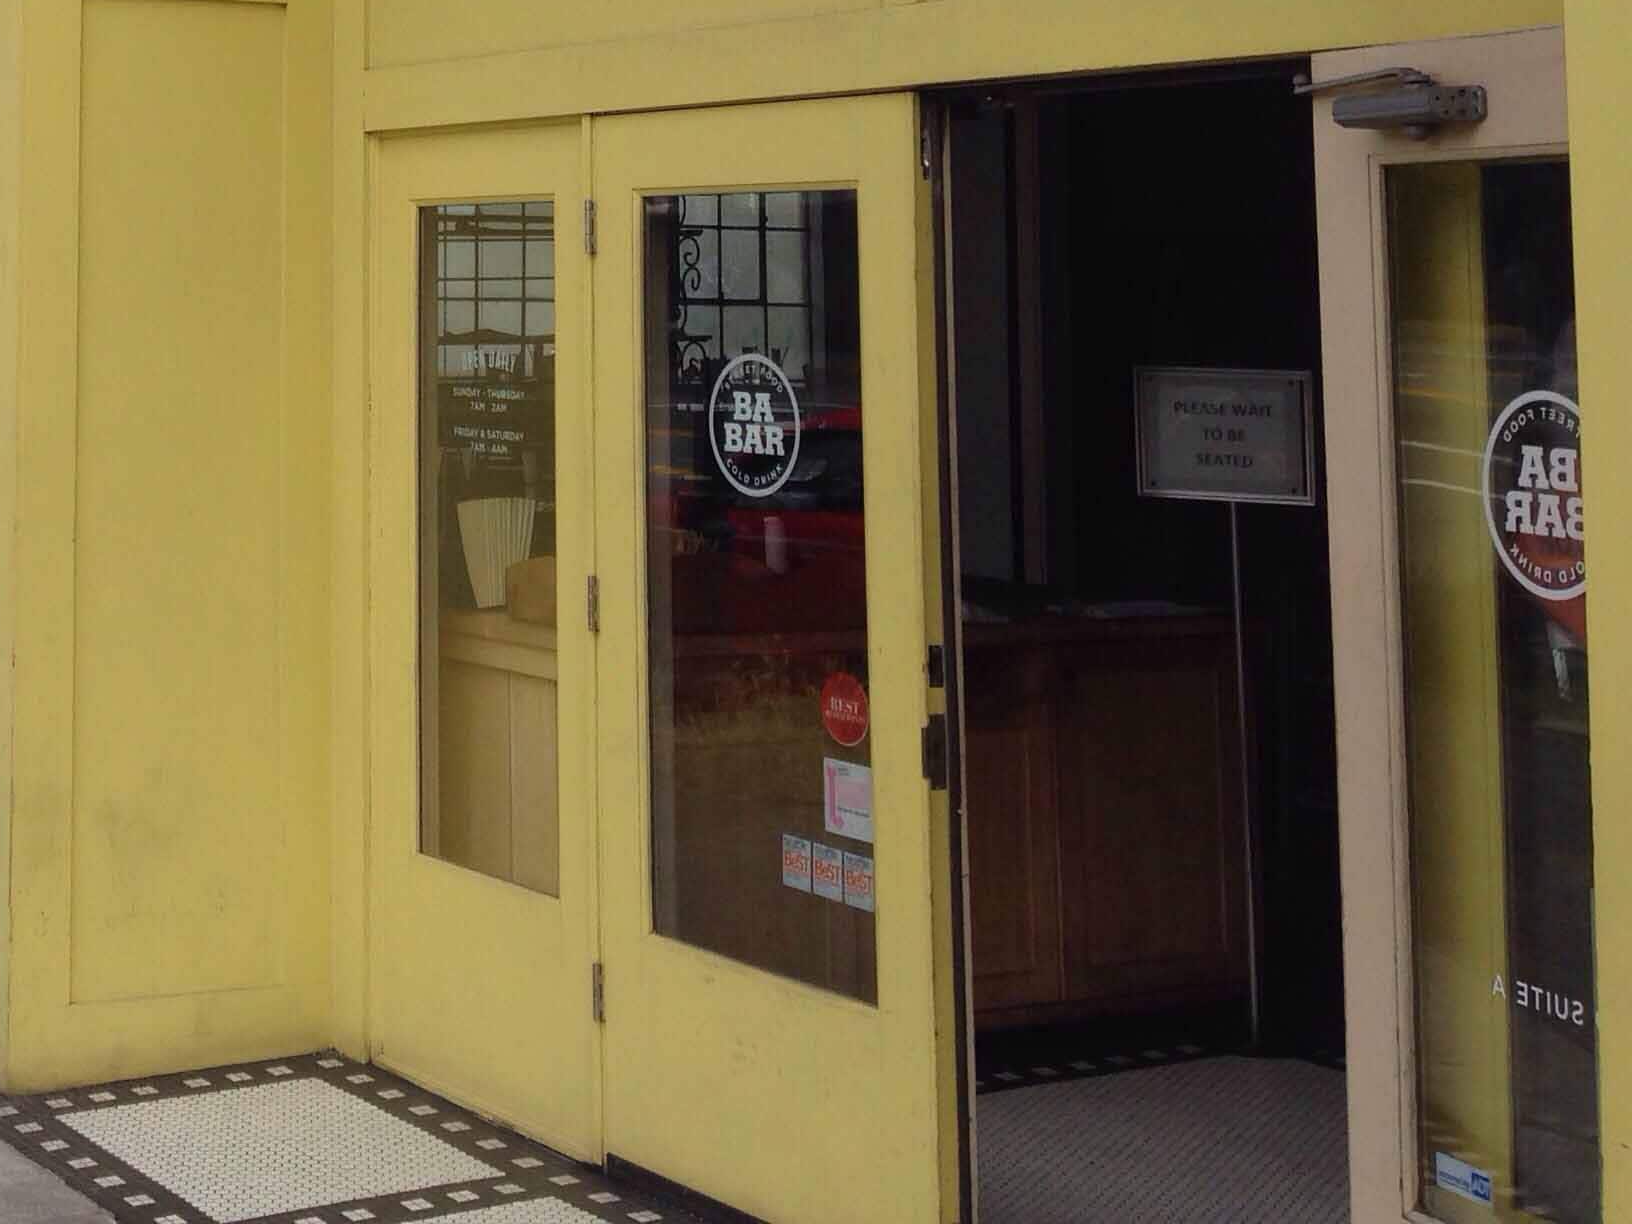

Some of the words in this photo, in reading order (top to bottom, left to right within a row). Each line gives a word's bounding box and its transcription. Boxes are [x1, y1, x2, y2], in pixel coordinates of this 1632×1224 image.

[732, 390, 775, 424] BA
[1173, 400, 1226, 417] PLEASE
[1232, 403, 1273, 418] WAIT
[487, 429, 525, 441] SATURDAY
[723, 422, 785, 457] BAR
[1203, 428, 1223, 442] TO
[1227, 429, 1245, 443] BE
[1196, 453, 1254, 469] SEATED
[726, 458, 751, 483] COLD
[753, 463, 784, 486] DRINK
